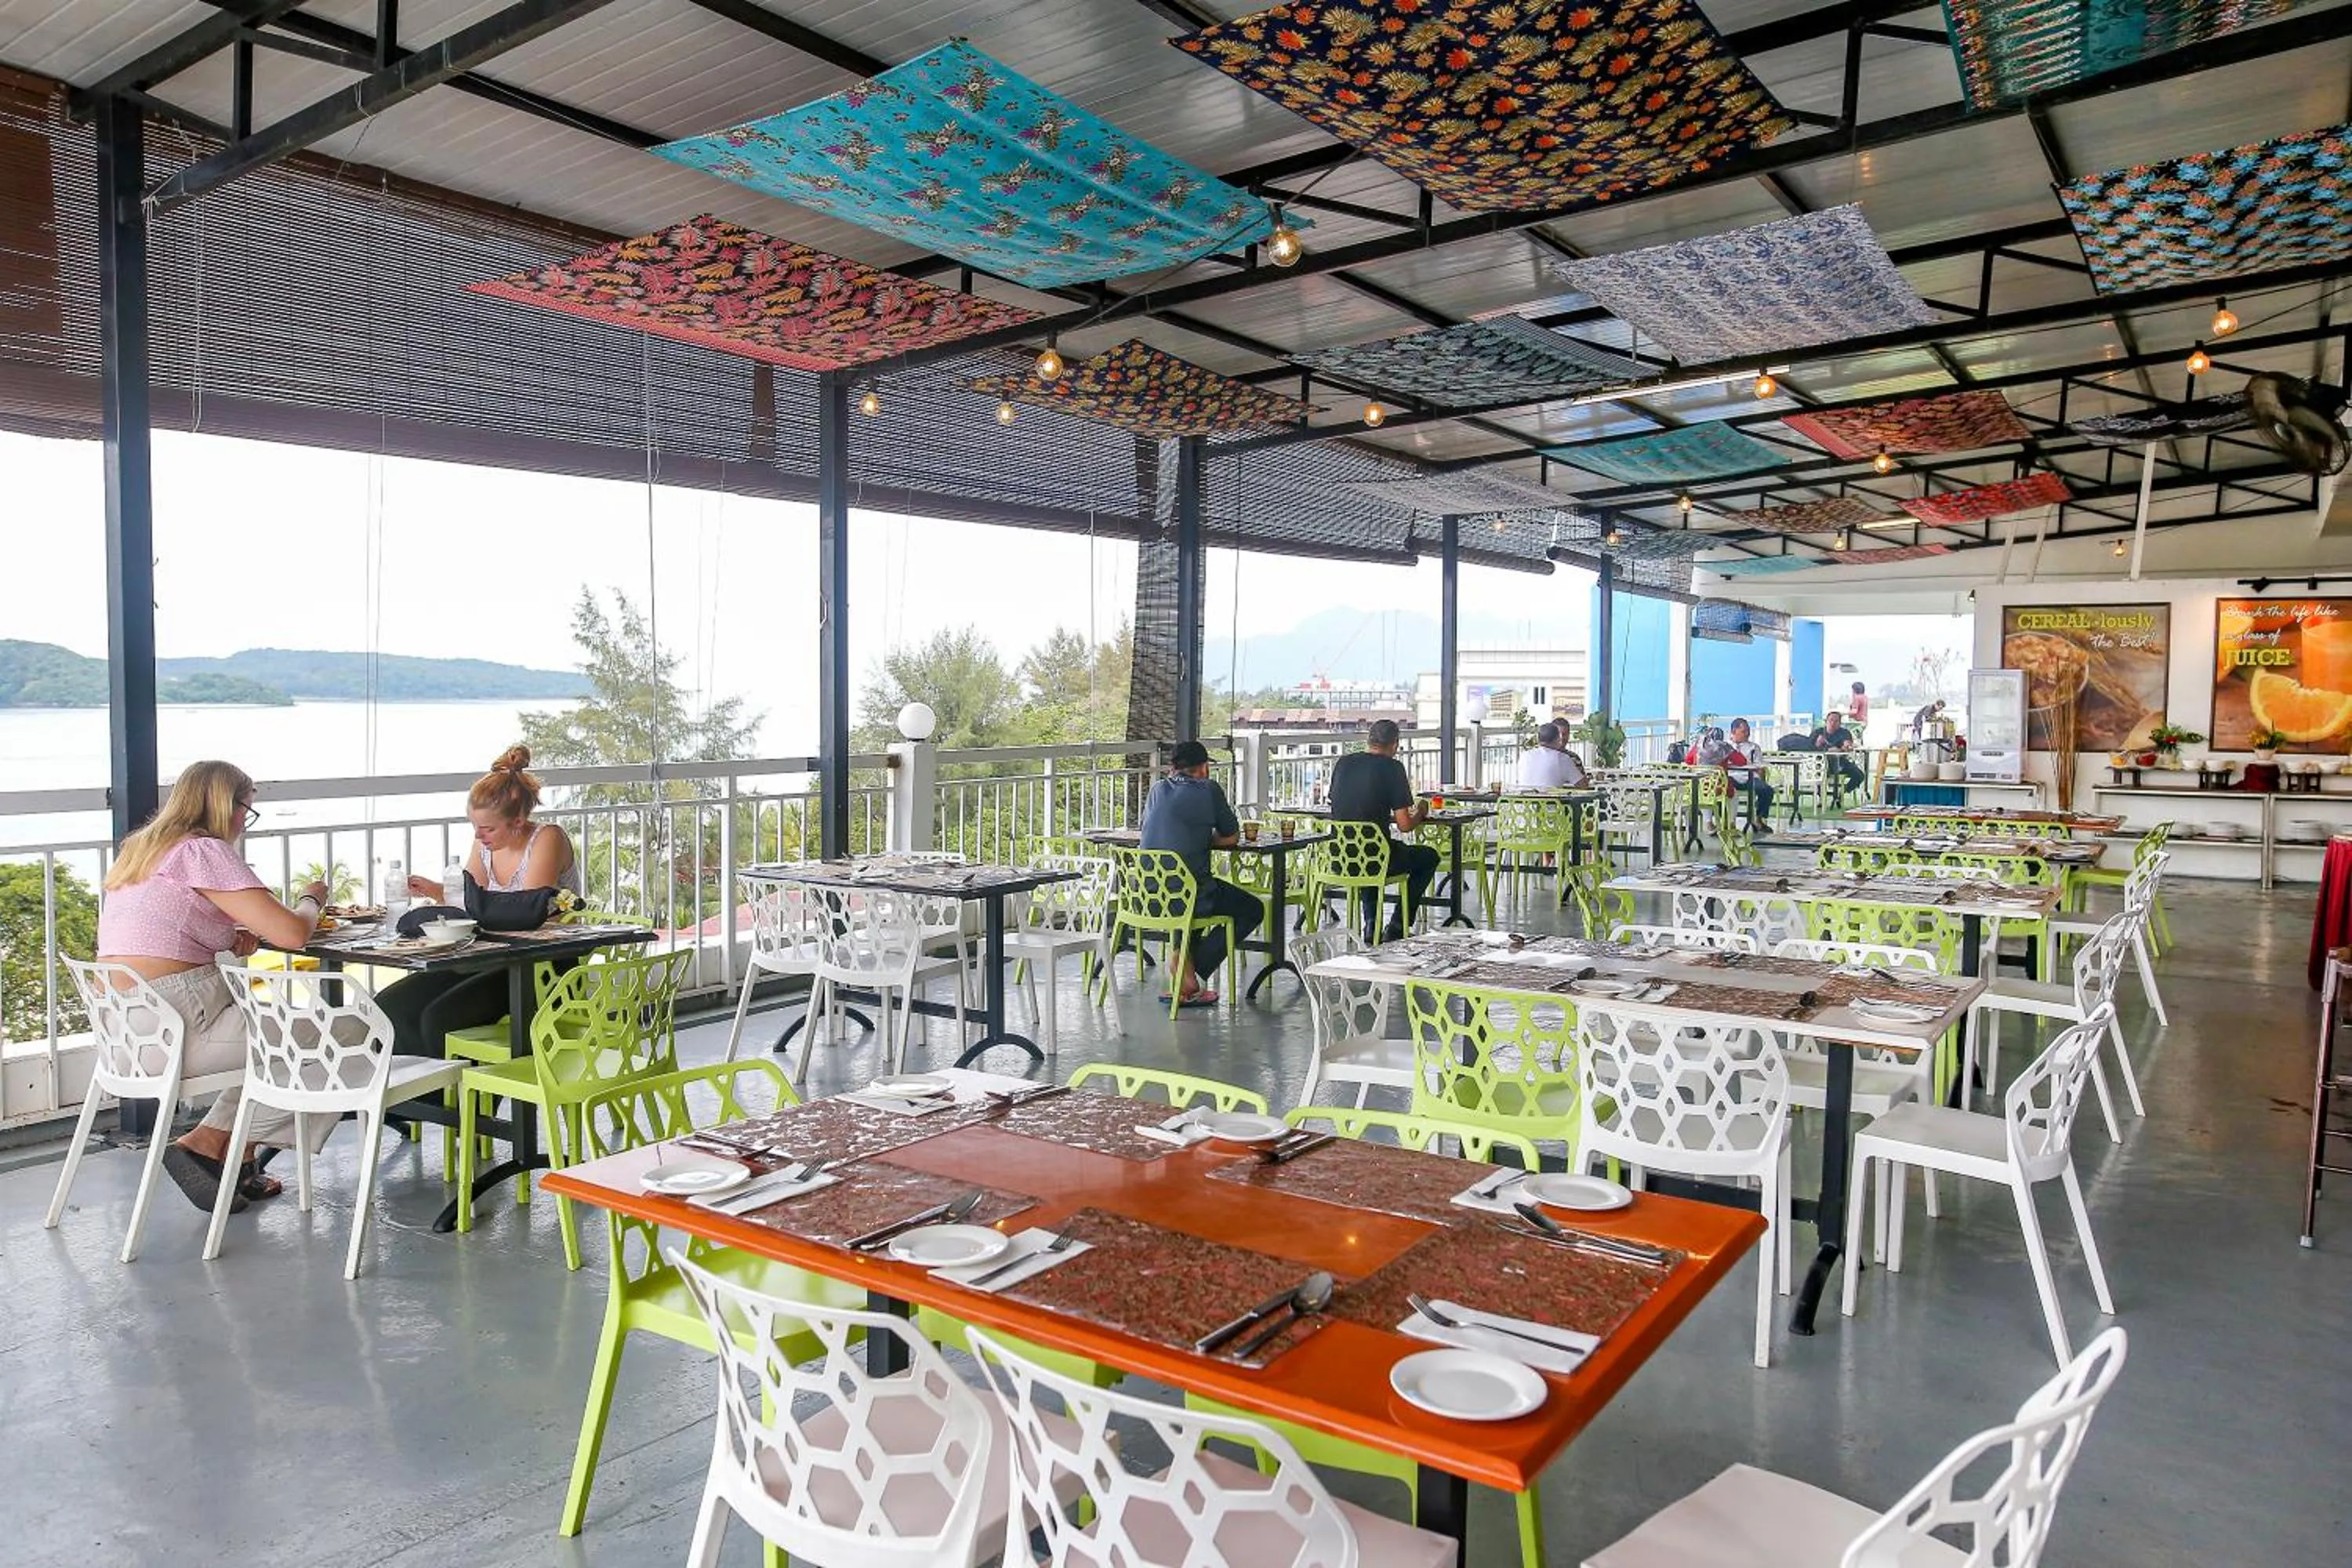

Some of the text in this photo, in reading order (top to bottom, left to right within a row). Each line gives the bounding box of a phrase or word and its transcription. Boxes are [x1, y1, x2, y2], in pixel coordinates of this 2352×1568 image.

[2265, 604, 2286, 617] the
[2314, 604, 2340, 615] like
[2089, 633, 2114, 648] the
[2268, 628, 2281, 646] of
[2223, 648, 2290, 670] JUICE
